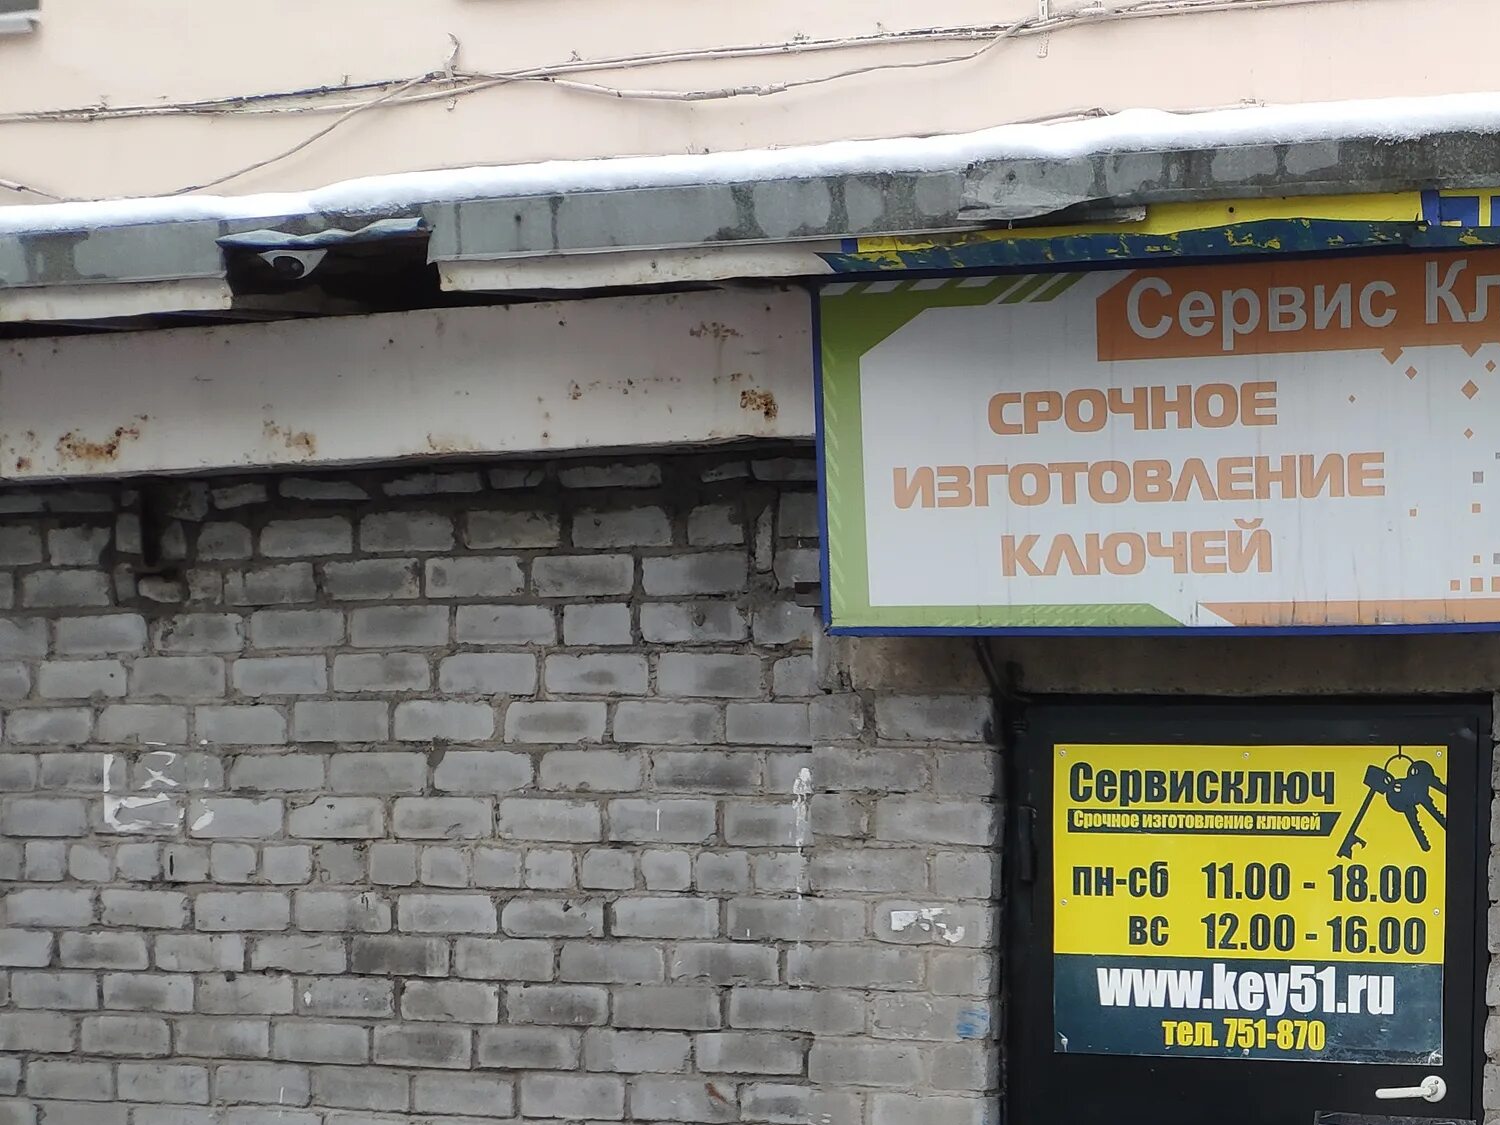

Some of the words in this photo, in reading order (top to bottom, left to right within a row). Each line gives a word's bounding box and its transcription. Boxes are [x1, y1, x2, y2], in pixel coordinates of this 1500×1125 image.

[1126, 276, 1399, 351] Сервис
[988, 381, 1278, 435] СРОЧНОЕ
[893, 451, 1386, 510] ИЗГОТОВЛЕНИЕ
[1001, 519, 1273, 578] КЛЮЧЕЙ
[1069, 762, 1336, 807] Сервисключ
[1073, 810, 1139, 830] Срочное
[1143, 813, 1253, 831] изготовление
[1256, 812, 1321, 831] ключей
[1072, 861, 1169, 898] пн-сб
[1201, 862, 1291, 901] 11.00
[1327, 864, 1427, 904] 18.00
[1128, 915, 1169, 946] вс
[1201, 913, 1296, 951] 12.00
[1326, 915, 1427, 955] 16.00
[1096, 963, 1395, 1016] www.key51.ru
[1162, 1020, 1219, 1047] тел.
[1223, 1017, 1326, 1051] 751-870
